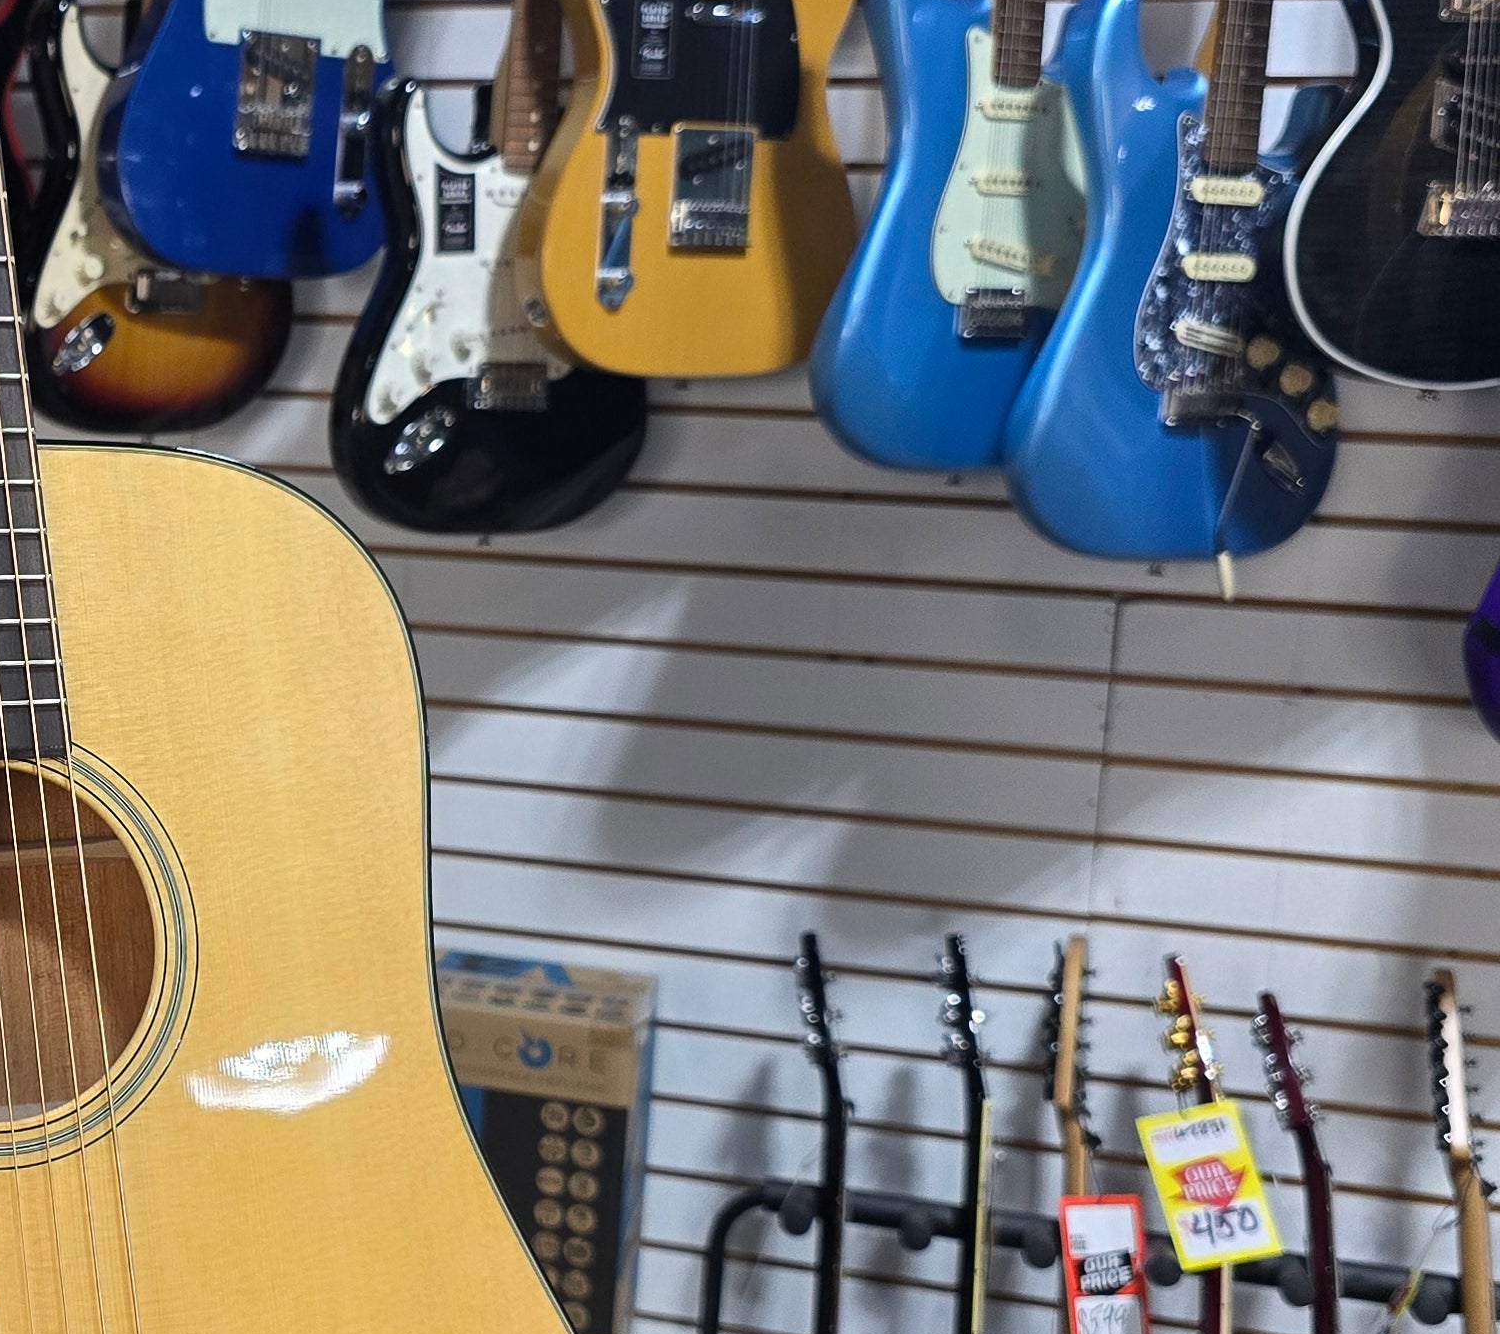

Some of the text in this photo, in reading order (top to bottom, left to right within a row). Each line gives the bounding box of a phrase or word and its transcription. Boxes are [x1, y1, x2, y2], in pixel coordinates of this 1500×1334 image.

[1184, 1162, 1227, 1183] OUR
[1182, 1175, 1237, 1202] PRICE
[1083, 1251, 1122, 1273] OUR
[1080, 1266, 1134, 1293] PRICE
